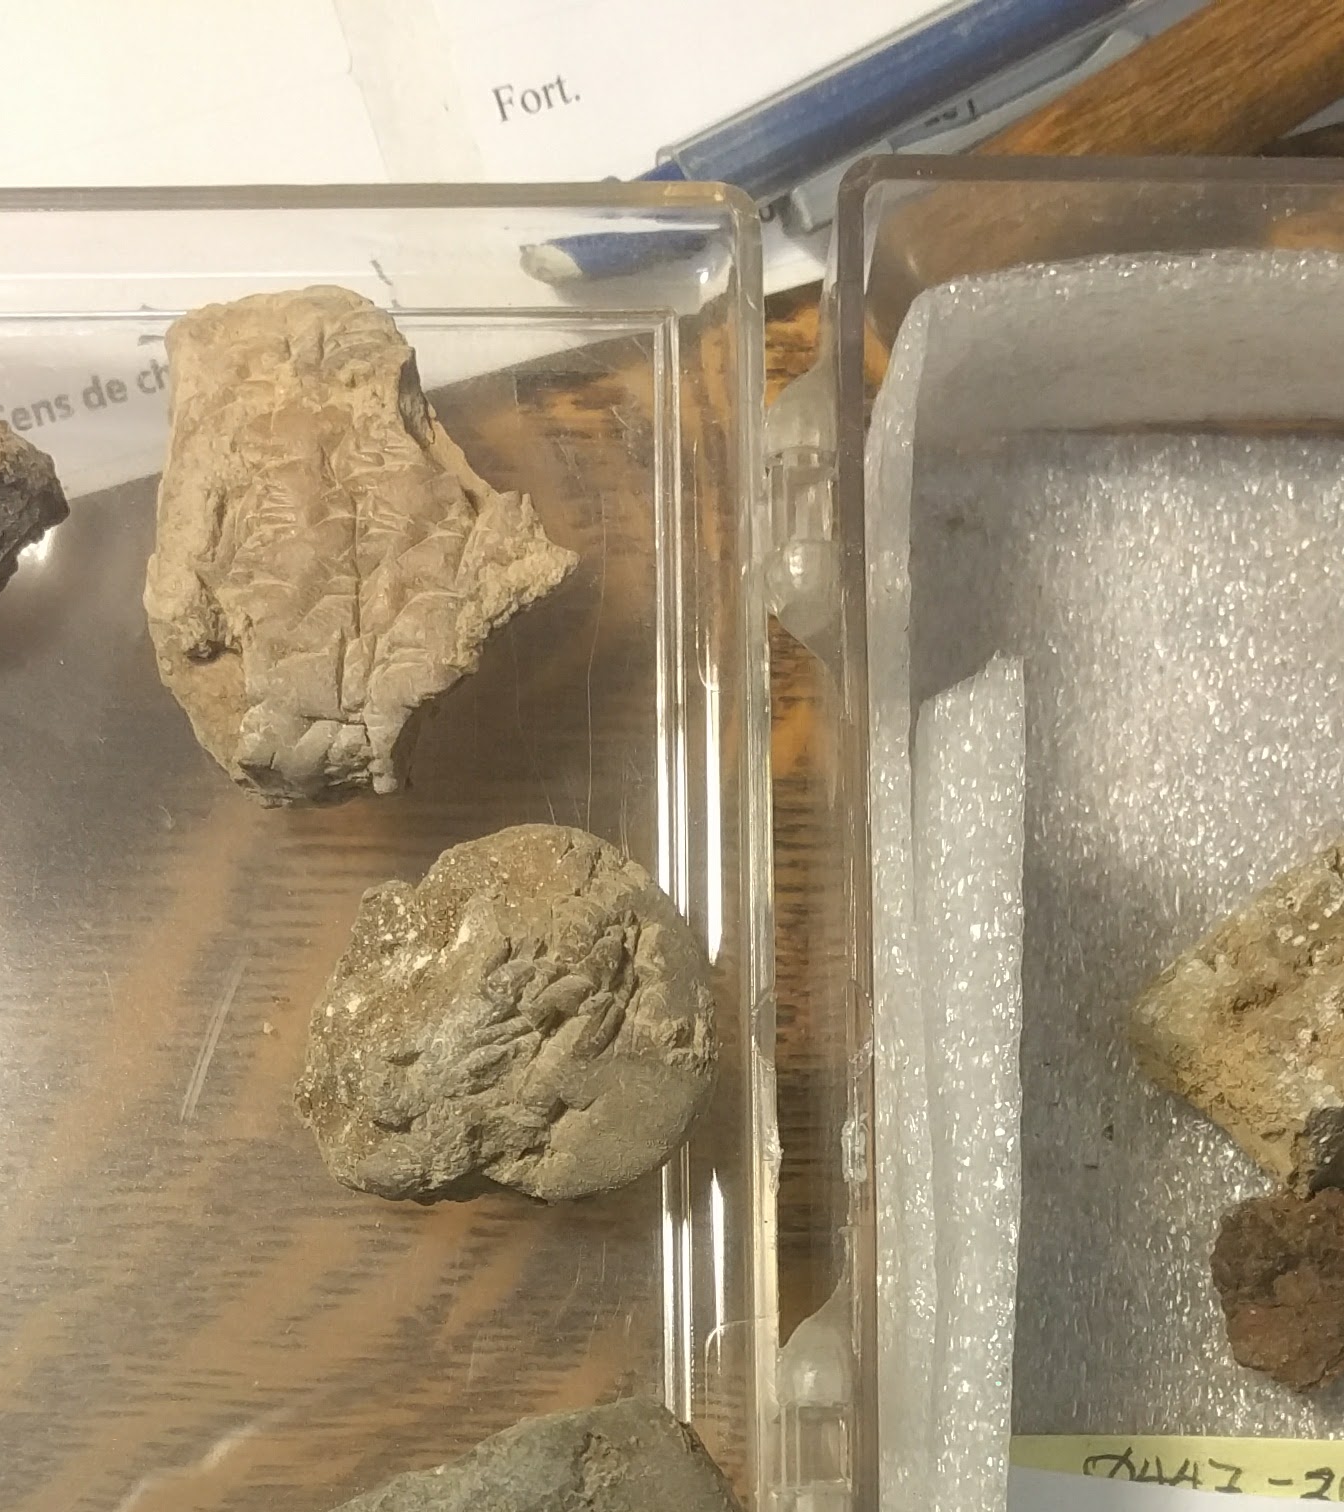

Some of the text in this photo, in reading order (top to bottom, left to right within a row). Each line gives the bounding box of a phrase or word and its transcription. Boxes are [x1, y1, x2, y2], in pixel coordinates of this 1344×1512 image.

[492, 75, 581, 123] Fort.
[82, 374, 128, 410] de
[136, 358, 170, 395] ch
